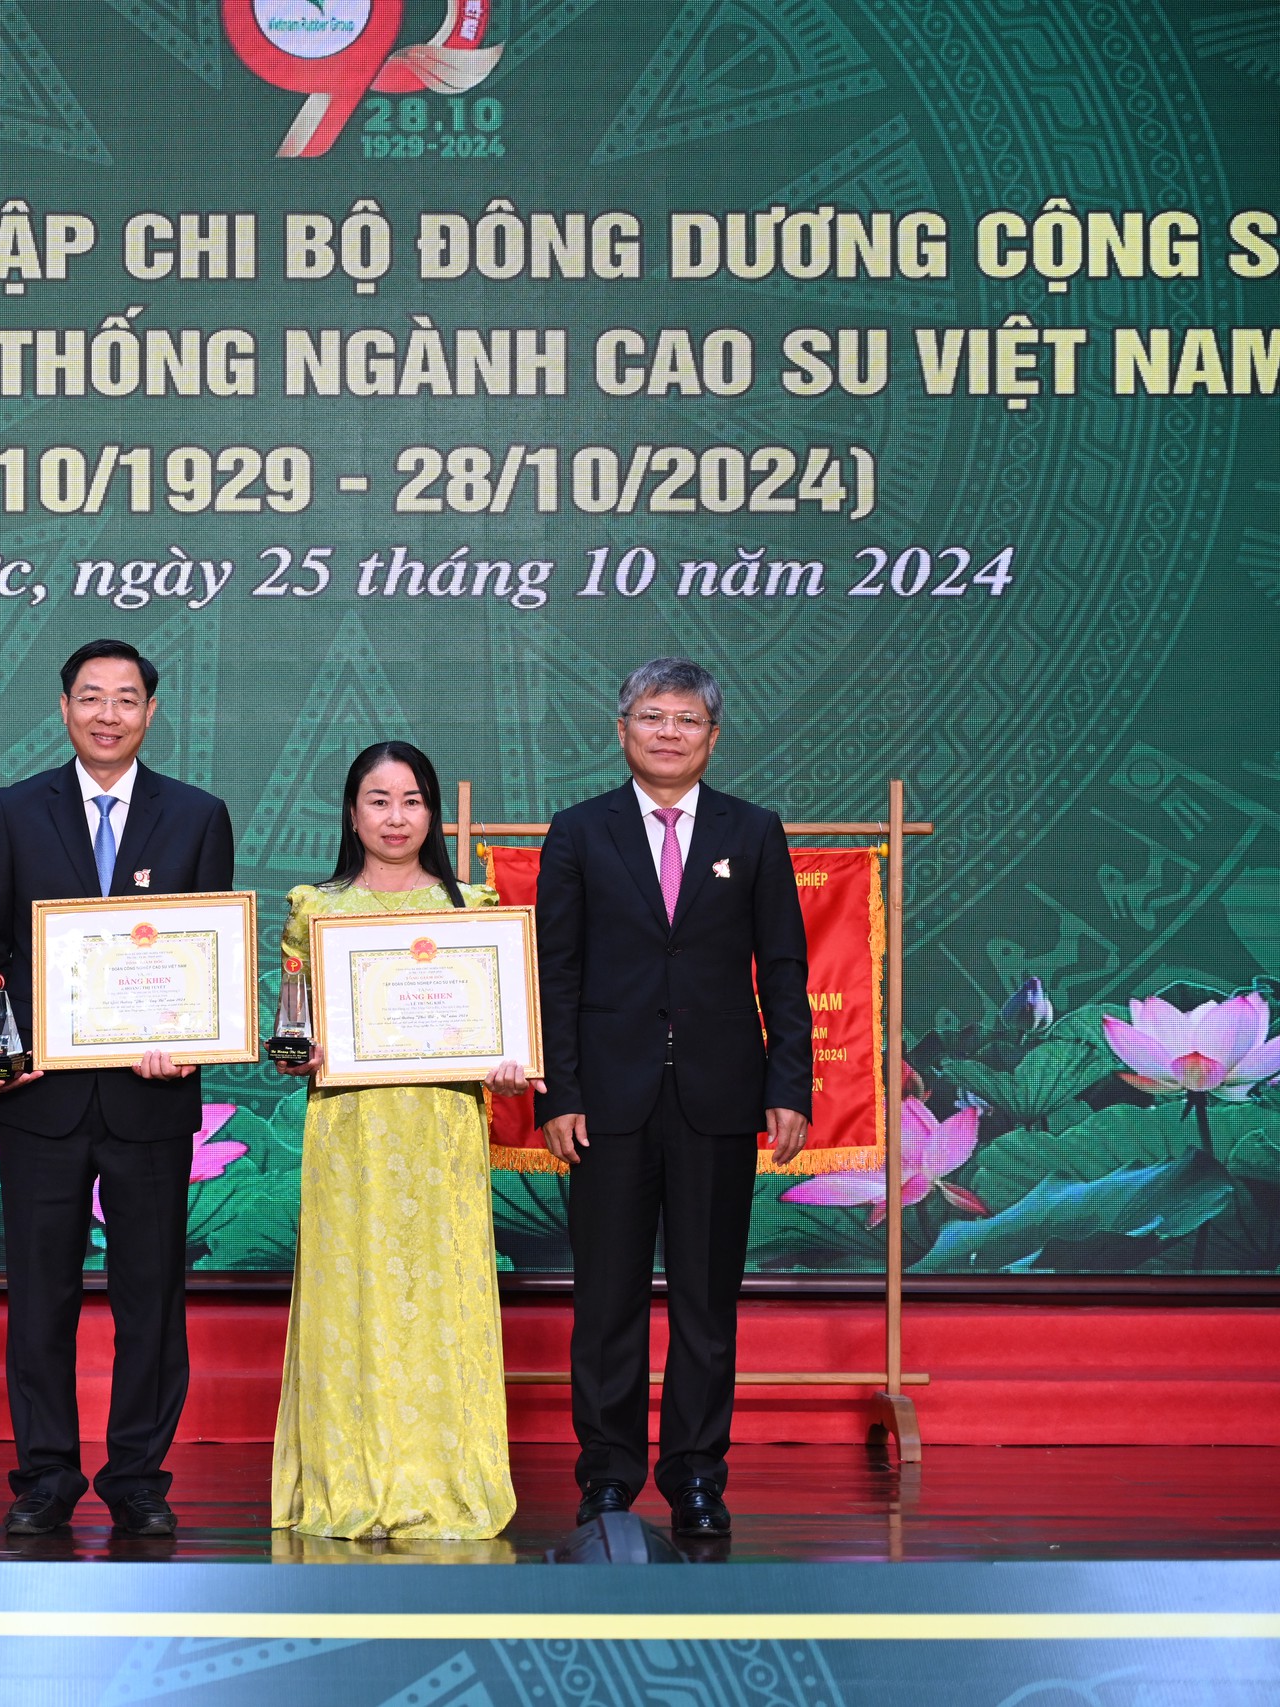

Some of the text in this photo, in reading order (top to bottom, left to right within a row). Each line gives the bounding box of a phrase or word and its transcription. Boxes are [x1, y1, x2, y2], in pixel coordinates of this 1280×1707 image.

[364, 97, 504, 132] 28.10
[361, 135, 505, 158] 1929-2024
[125, 213, 255, 280] CHI
[286, 199, 390, 294] BỘ
[417, 199, 640, 279] ĐÔNG
[671, 206, 947, 278] DƯƠNG
[978, 198, 1199, 292] CỘNG
[285, 315, 566, 396] NGÀNH
[596, 329, 752, 395] CAO
[782, 329, 887, 395] SU
[916, 315, 1086, 409] VIỆT
[1115, 329, 1280, 394] NAM
[395, 445, 874, 519] 28/10/2024)
[74, 546, 233, 610] ngày
[252, 546, 332, 597] 25
[356, 546, 554, 610] tháng
[579, 547, 656, 596] 10
[677, 548, 824, 597] năm
[849, 547, 1013, 596] 2024
[795, 869, 829, 890] GHIỆP
[807, 992, 843, 1012] NAM
[811, 1025, 828, 1040] ĂM
[813, 1047, 847, 1063] /2024)
